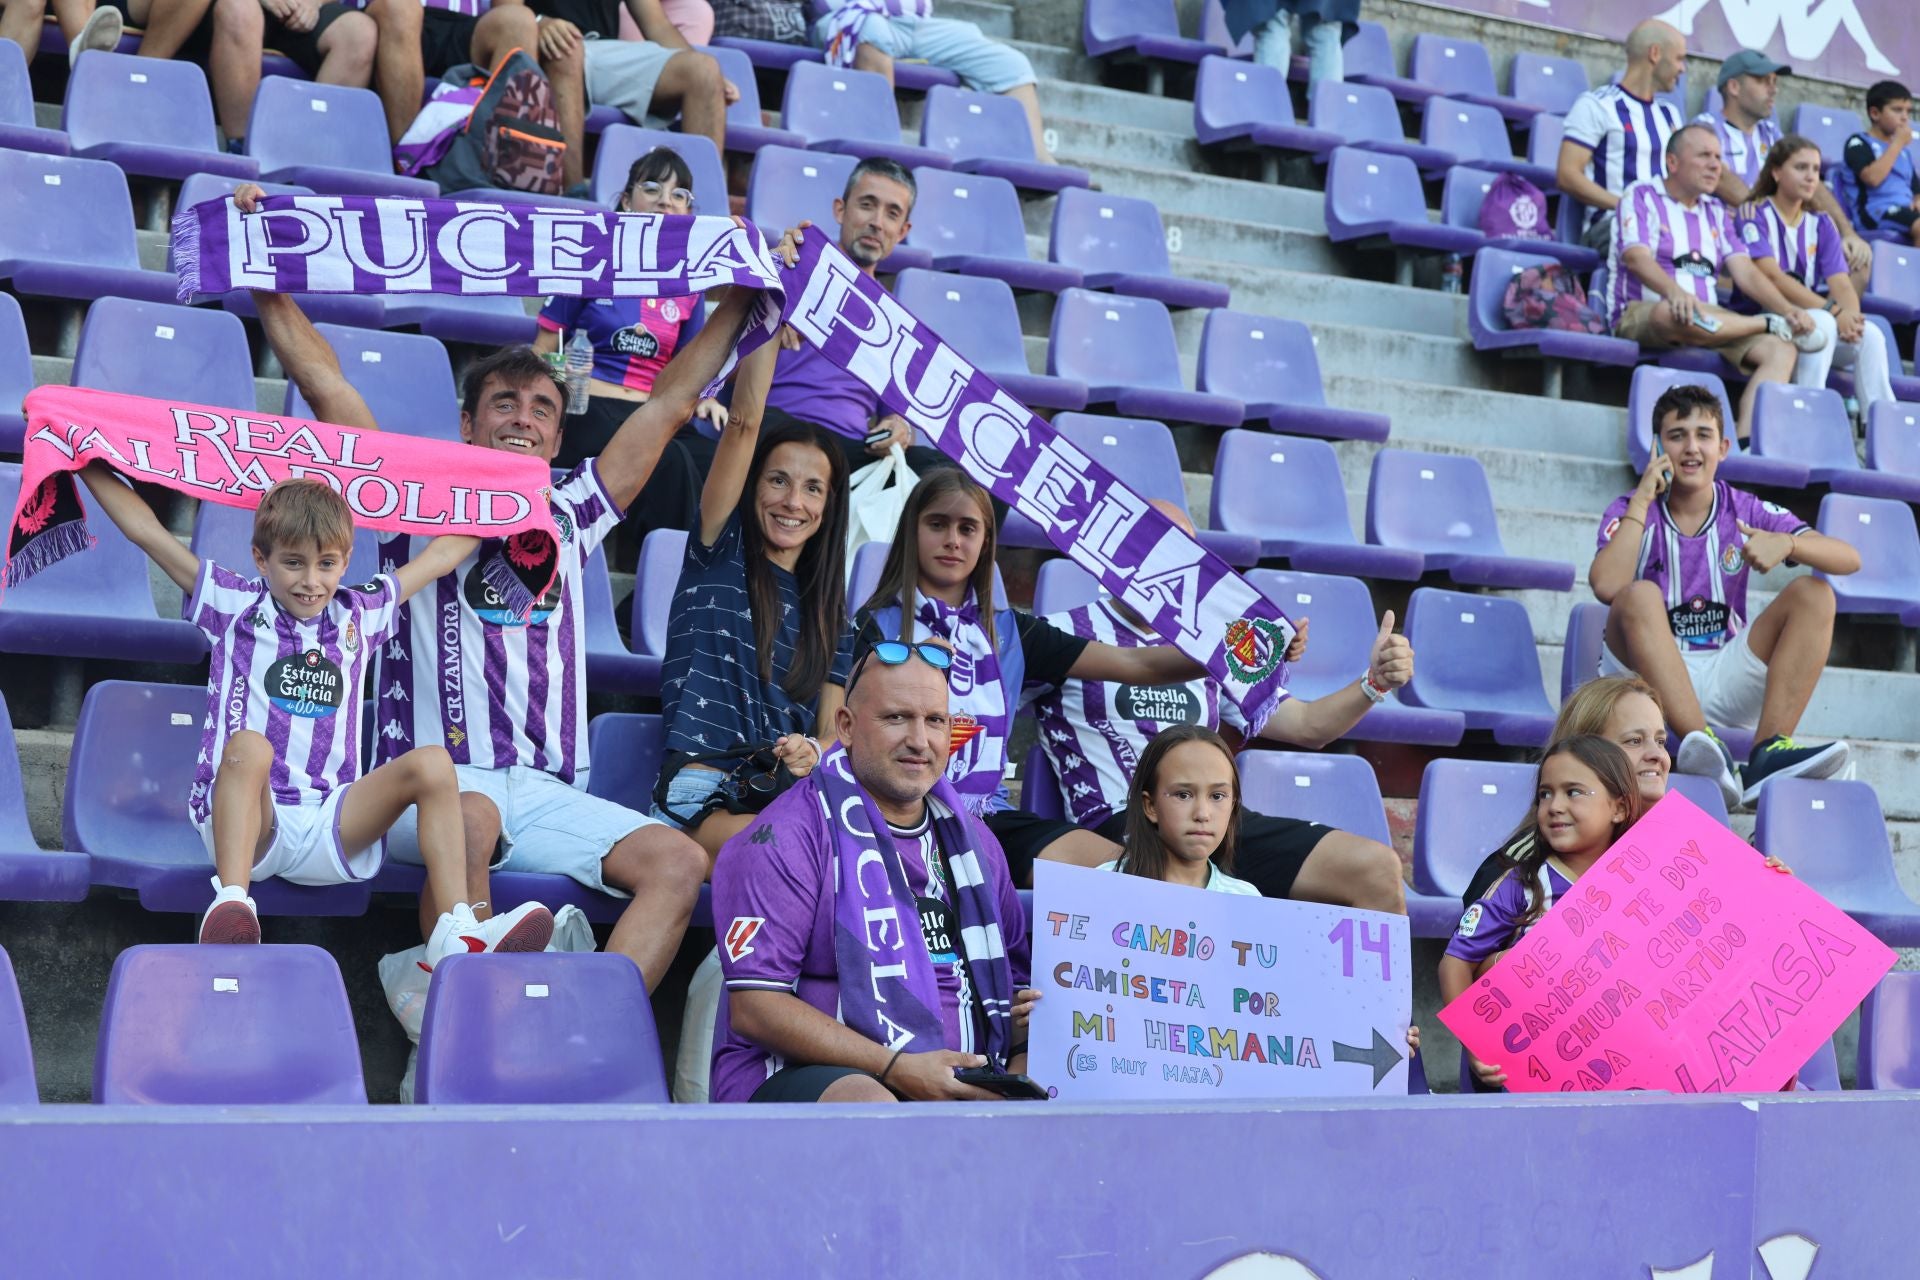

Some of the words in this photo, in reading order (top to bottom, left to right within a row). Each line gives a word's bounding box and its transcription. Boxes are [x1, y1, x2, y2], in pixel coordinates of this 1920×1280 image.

[1043, 128, 1058, 153] 9
[240, 207, 781, 283] PUCELA
[1166, 226, 1182, 252] 8
[618, 331, 655, 349] Estrella
[169, 407, 384, 472] REAL
[804, 263, 1202, 640] PUCELA
[1672, 609, 1724, 626] Estrella
[1675, 622, 1722, 637] Galicia
[280, 663, 336, 687] Estrella
[1129, 686, 1188, 704] Estrella
[1132, 701, 1186, 721] Galicia
[1623, 888, 1664, 926] TE
[1660, 840, 1708, 891] DOY
[1512, 936, 1562, 988] ME
[1562, 885, 1612, 937] DAS
[1606, 845, 1651, 884] TU
[1047, 911, 1090, 940] TE
[1232, 940, 1277, 968] TU
[1328, 918, 1391, 981] 14
[1233, 988, 1281, 1017] POR
[1529, 1054, 1551, 1082] 1
[1556, 979, 1641, 1061] CHUPA
[1647, 887, 1722, 968] CHUPS
[1675, 919, 1857, 1093] LATASA
[1144, 1019, 1321, 1069] HERMANA
[1112, 1057, 1147, 1076] MUY
